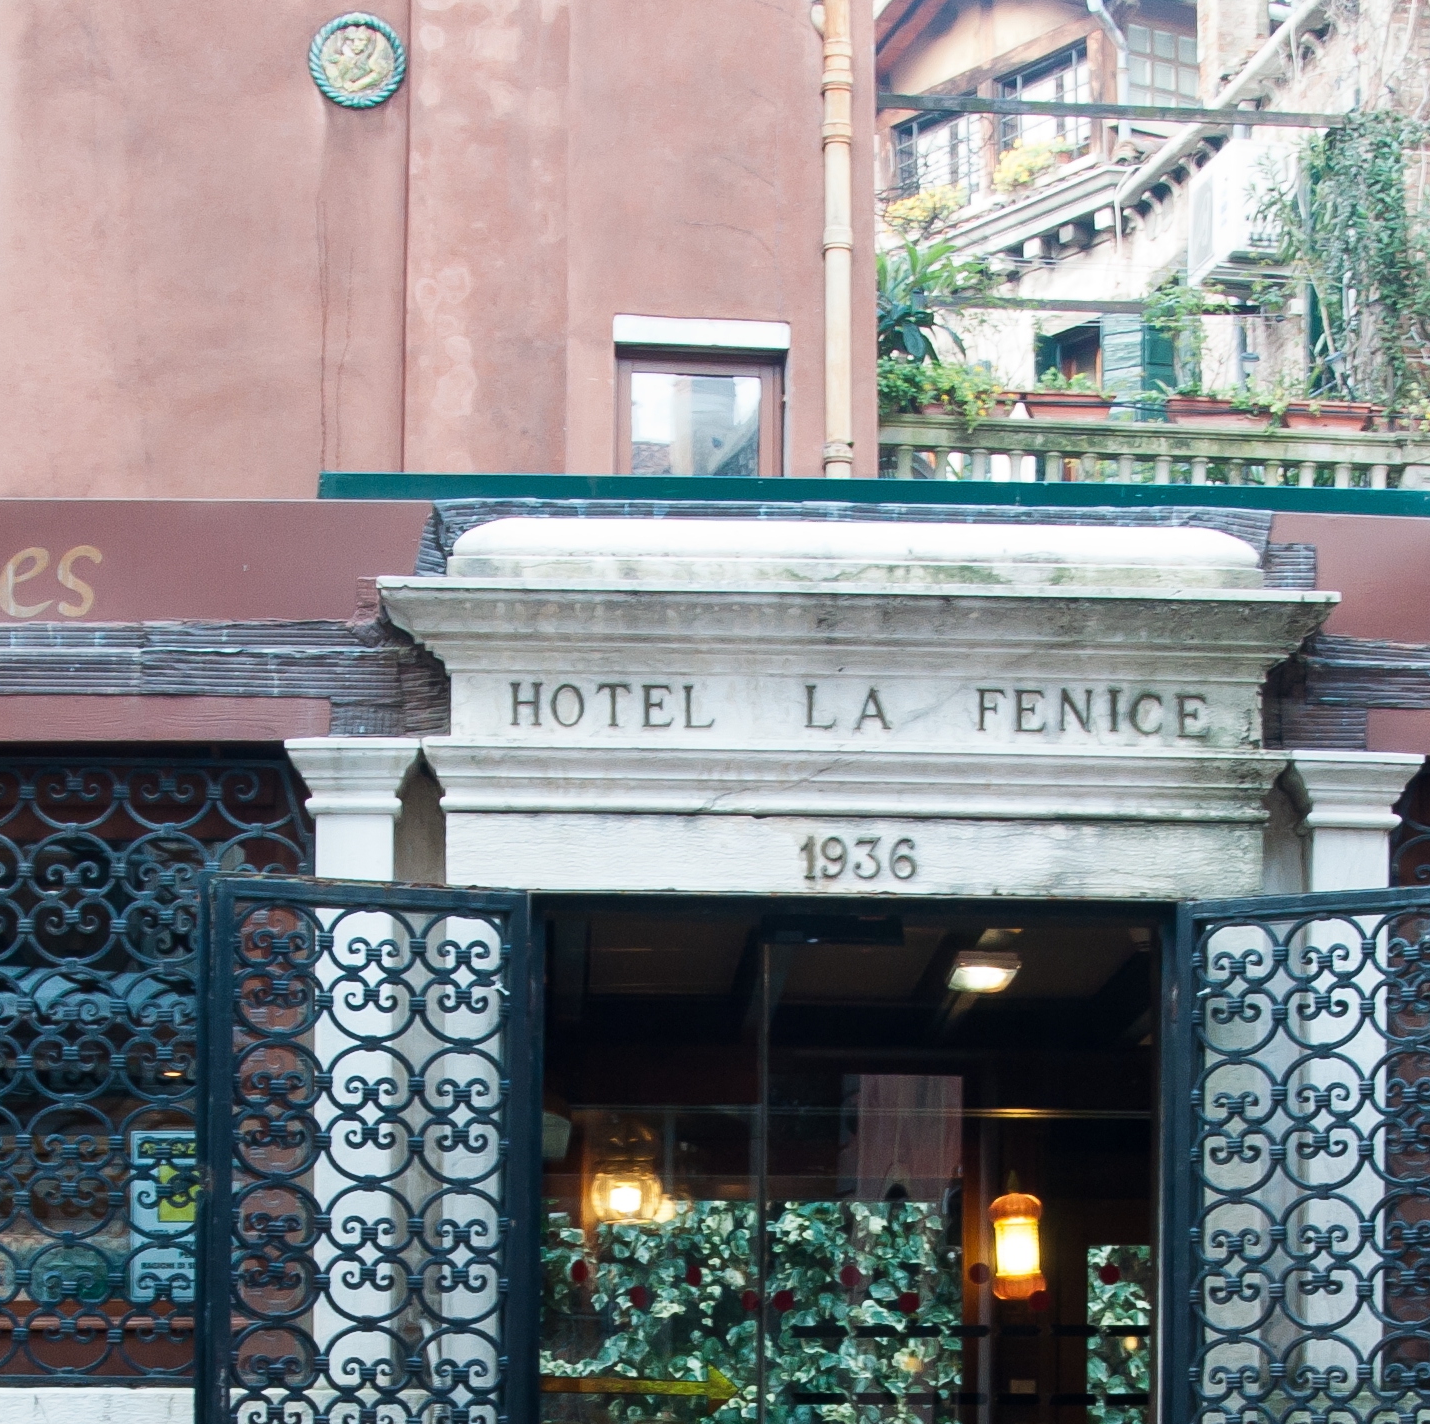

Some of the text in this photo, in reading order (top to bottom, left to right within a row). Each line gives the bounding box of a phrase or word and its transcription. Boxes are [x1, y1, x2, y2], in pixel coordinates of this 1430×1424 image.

[509, 682, 1212, 739] HOTEL LA FENICE
[799, 836, 919, 883] 1936
